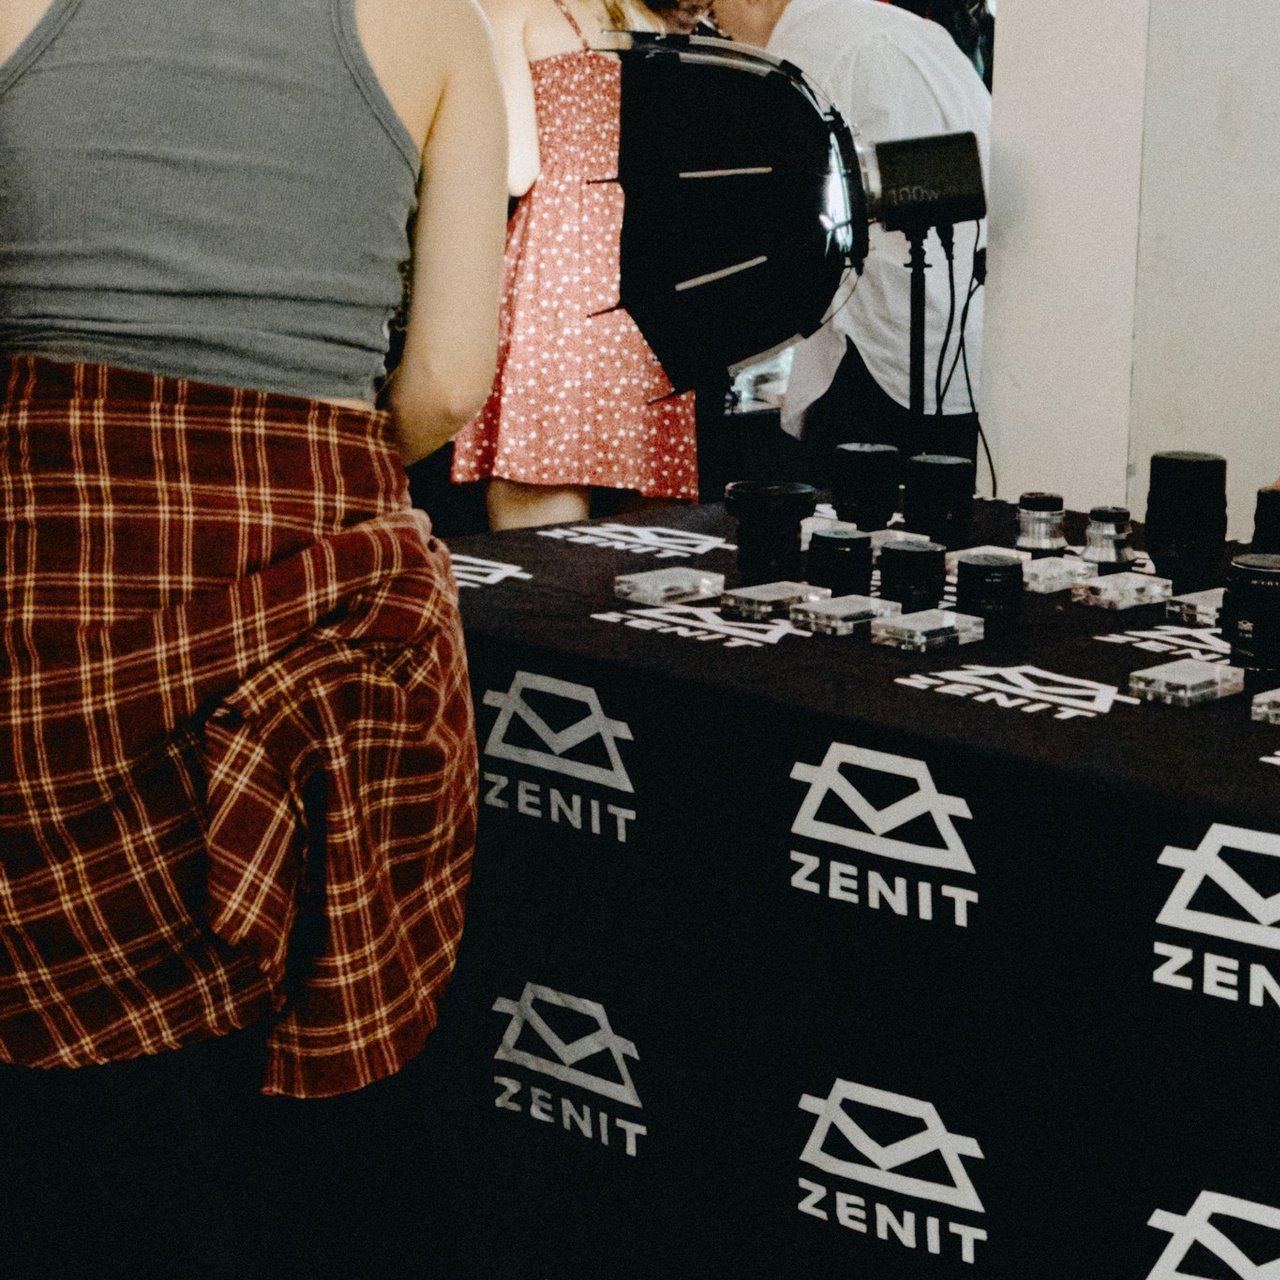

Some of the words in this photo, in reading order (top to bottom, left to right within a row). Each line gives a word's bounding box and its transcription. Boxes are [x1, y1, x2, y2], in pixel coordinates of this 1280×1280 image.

[483, 771, 636, 843] ZENIT
[790, 850, 979, 927] ZENIT
[494, 1076, 647, 1157] ZENIT
[798, 1177, 988, 1264] ZENIT
